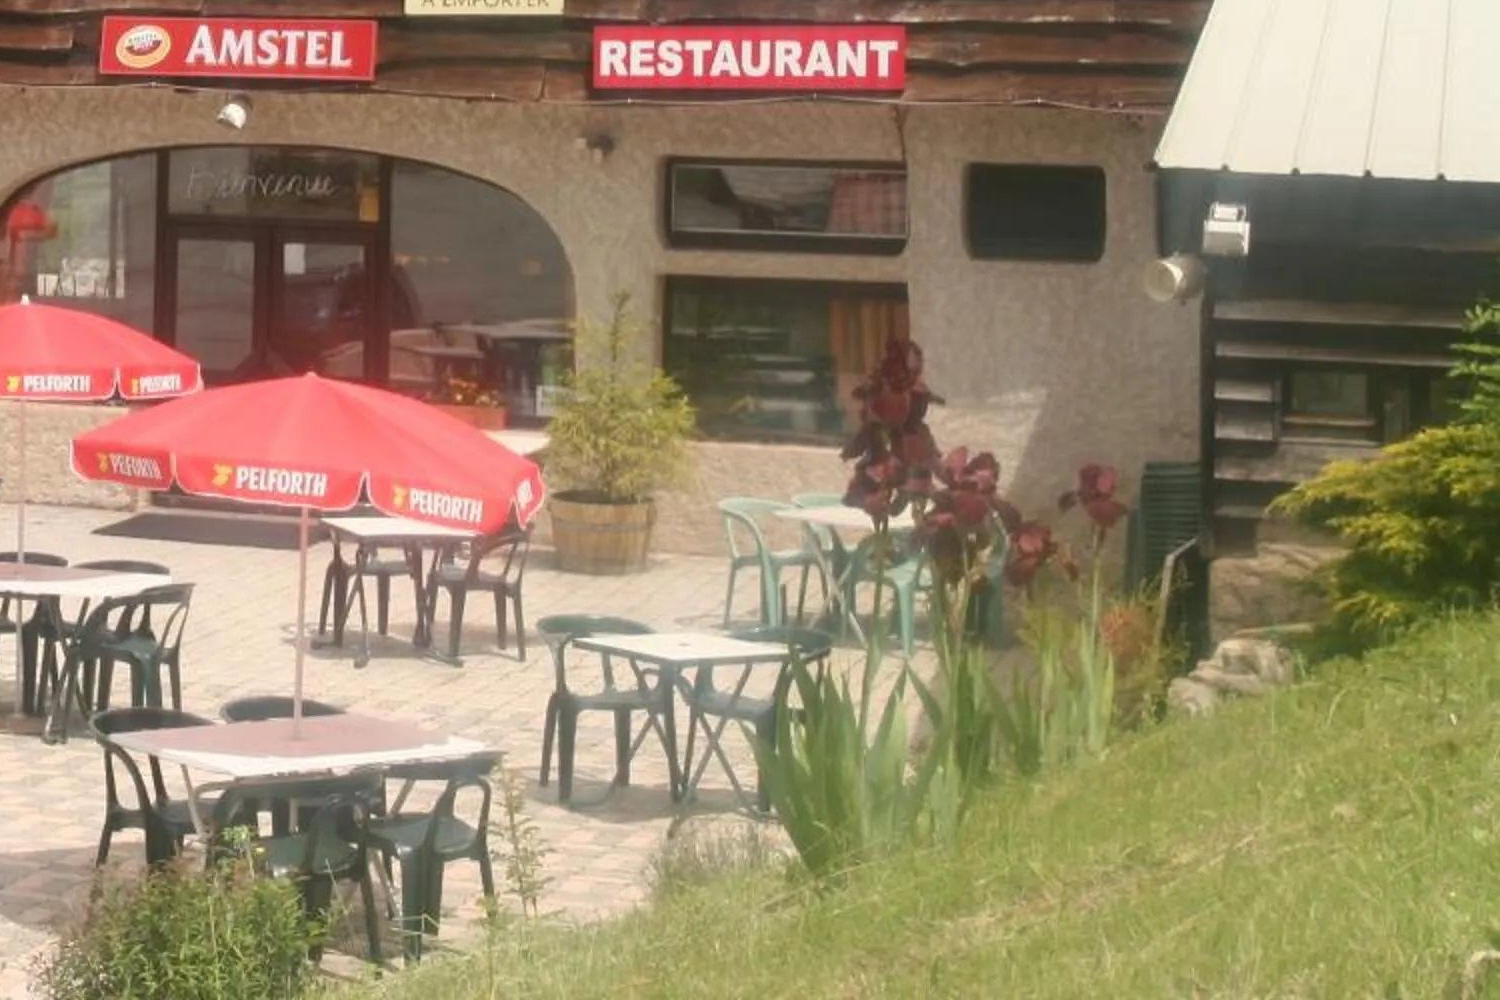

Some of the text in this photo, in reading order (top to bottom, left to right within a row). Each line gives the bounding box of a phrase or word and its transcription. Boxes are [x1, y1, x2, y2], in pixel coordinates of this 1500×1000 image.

[600, 39, 899, 77] RESTAURANT
[23, 375, 91, 393] PELFORTH
[236, 465, 327, 497] PELFORTH
[409, 487, 483, 523] PELFORTH
